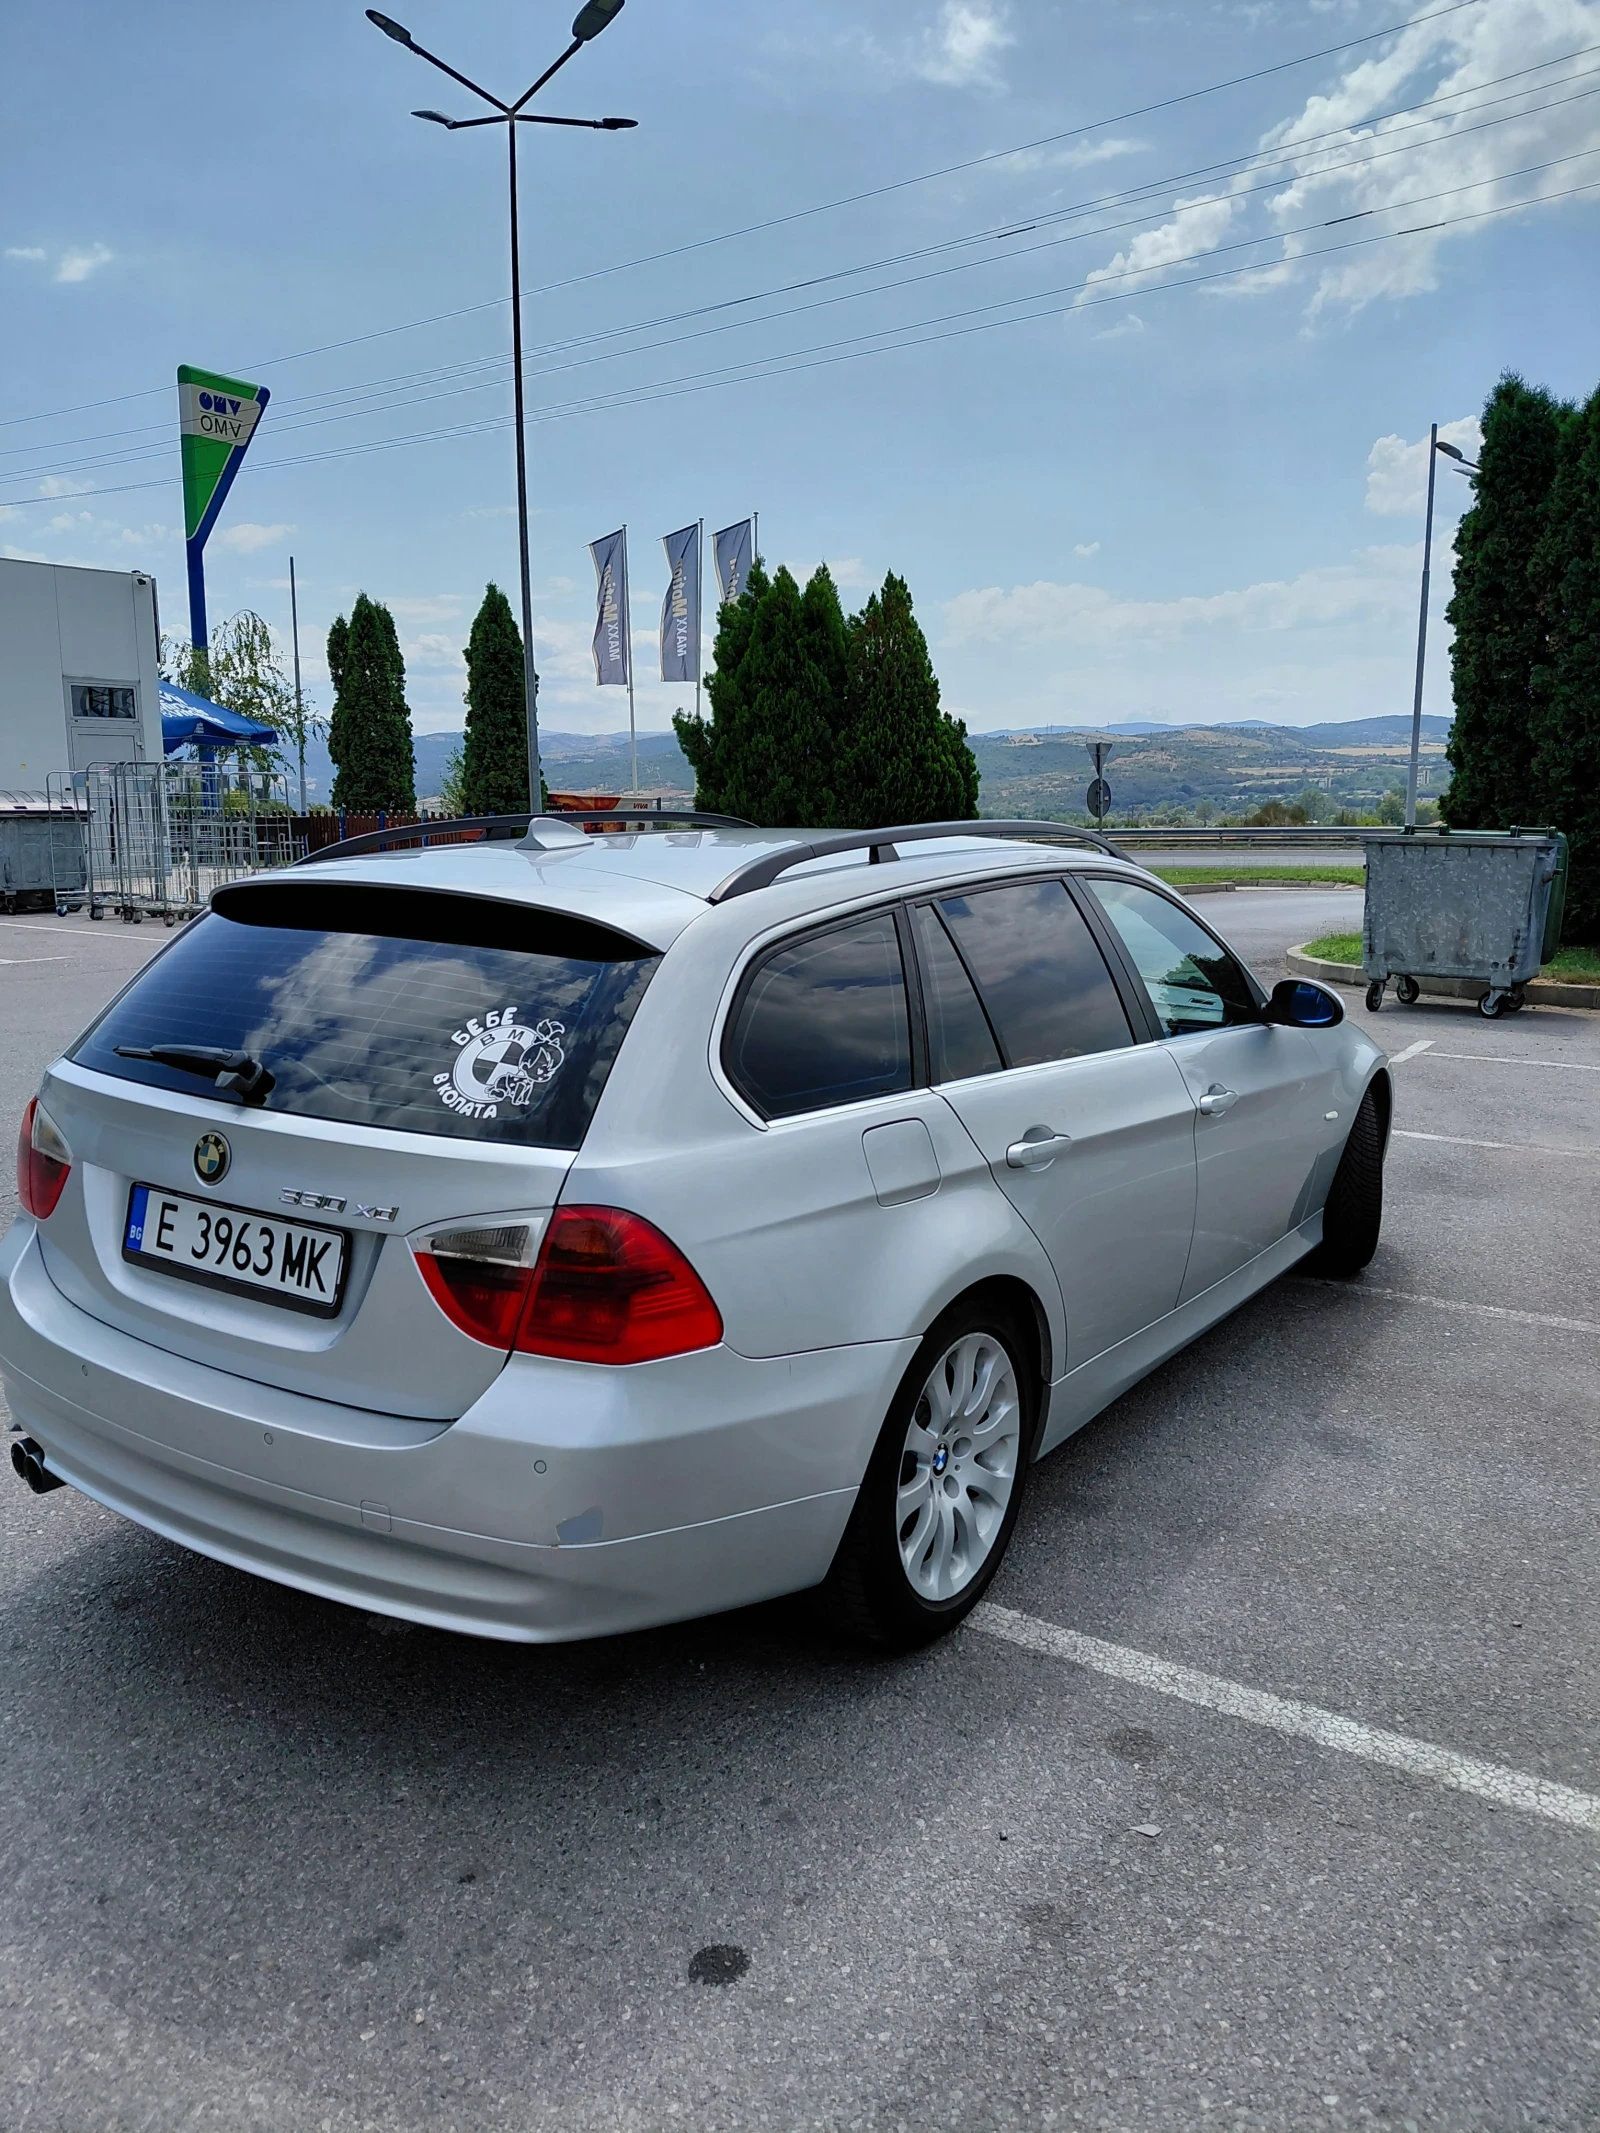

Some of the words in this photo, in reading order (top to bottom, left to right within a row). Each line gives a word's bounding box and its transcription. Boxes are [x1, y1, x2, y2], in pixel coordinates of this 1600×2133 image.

[200, 414, 242, 438] OMV
[633, 802, 649, 810] VIVA
[450, 1006, 518, 1046] БЕБЕ
[479, 1029, 526, 1047] BM
[198, 1135, 225, 1154] BMW
[279, 1187, 348, 1214] 330
[129, 1225, 142, 1241] BG
[191, 1211, 275, 1277] 3963
[280, 1232, 332, 1293] MK
